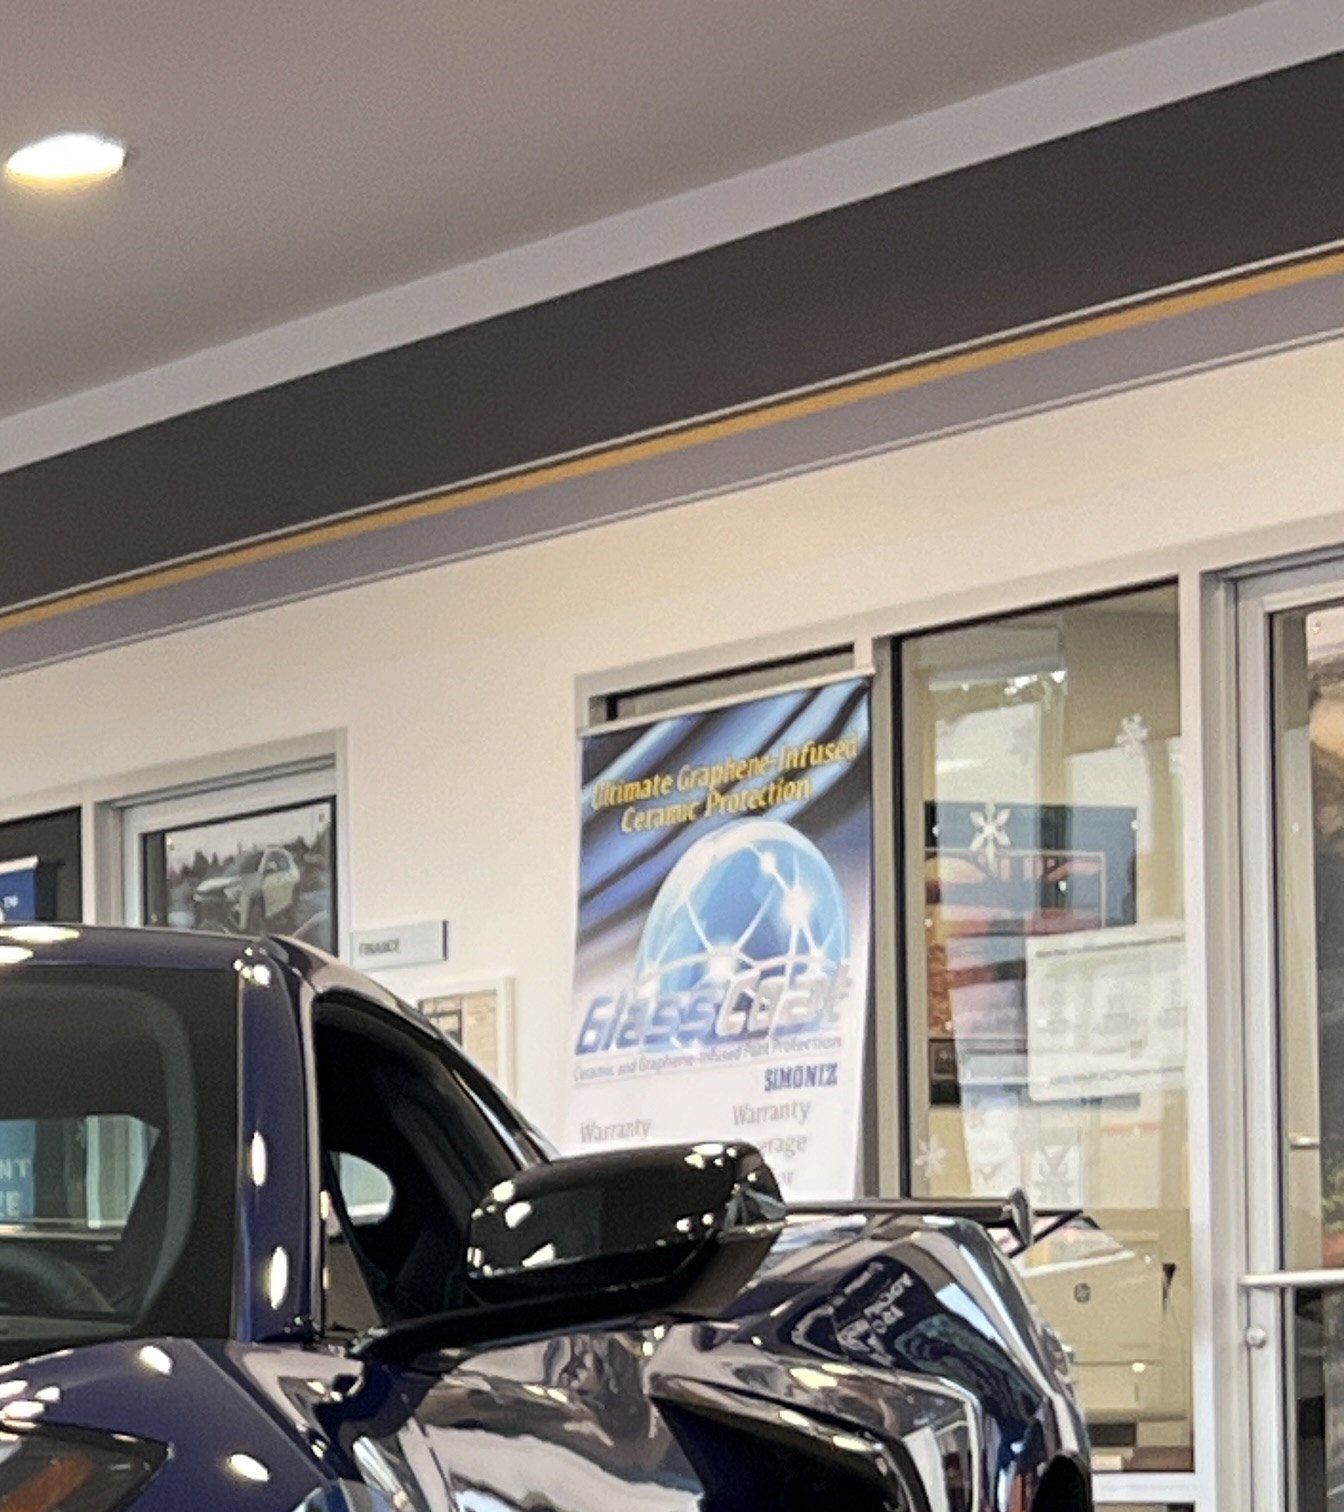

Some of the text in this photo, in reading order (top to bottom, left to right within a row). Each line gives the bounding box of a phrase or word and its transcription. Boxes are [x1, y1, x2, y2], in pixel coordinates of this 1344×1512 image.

[591, 771, 674, 812] Ultimate
[621, 776, 811, 833] Ceramic Protection
[764, 1061, 839, 1093] SIMONIZ
[732, 1099, 813, 1127] Warranty
[580, 1118, 652, 1145] Warranty
